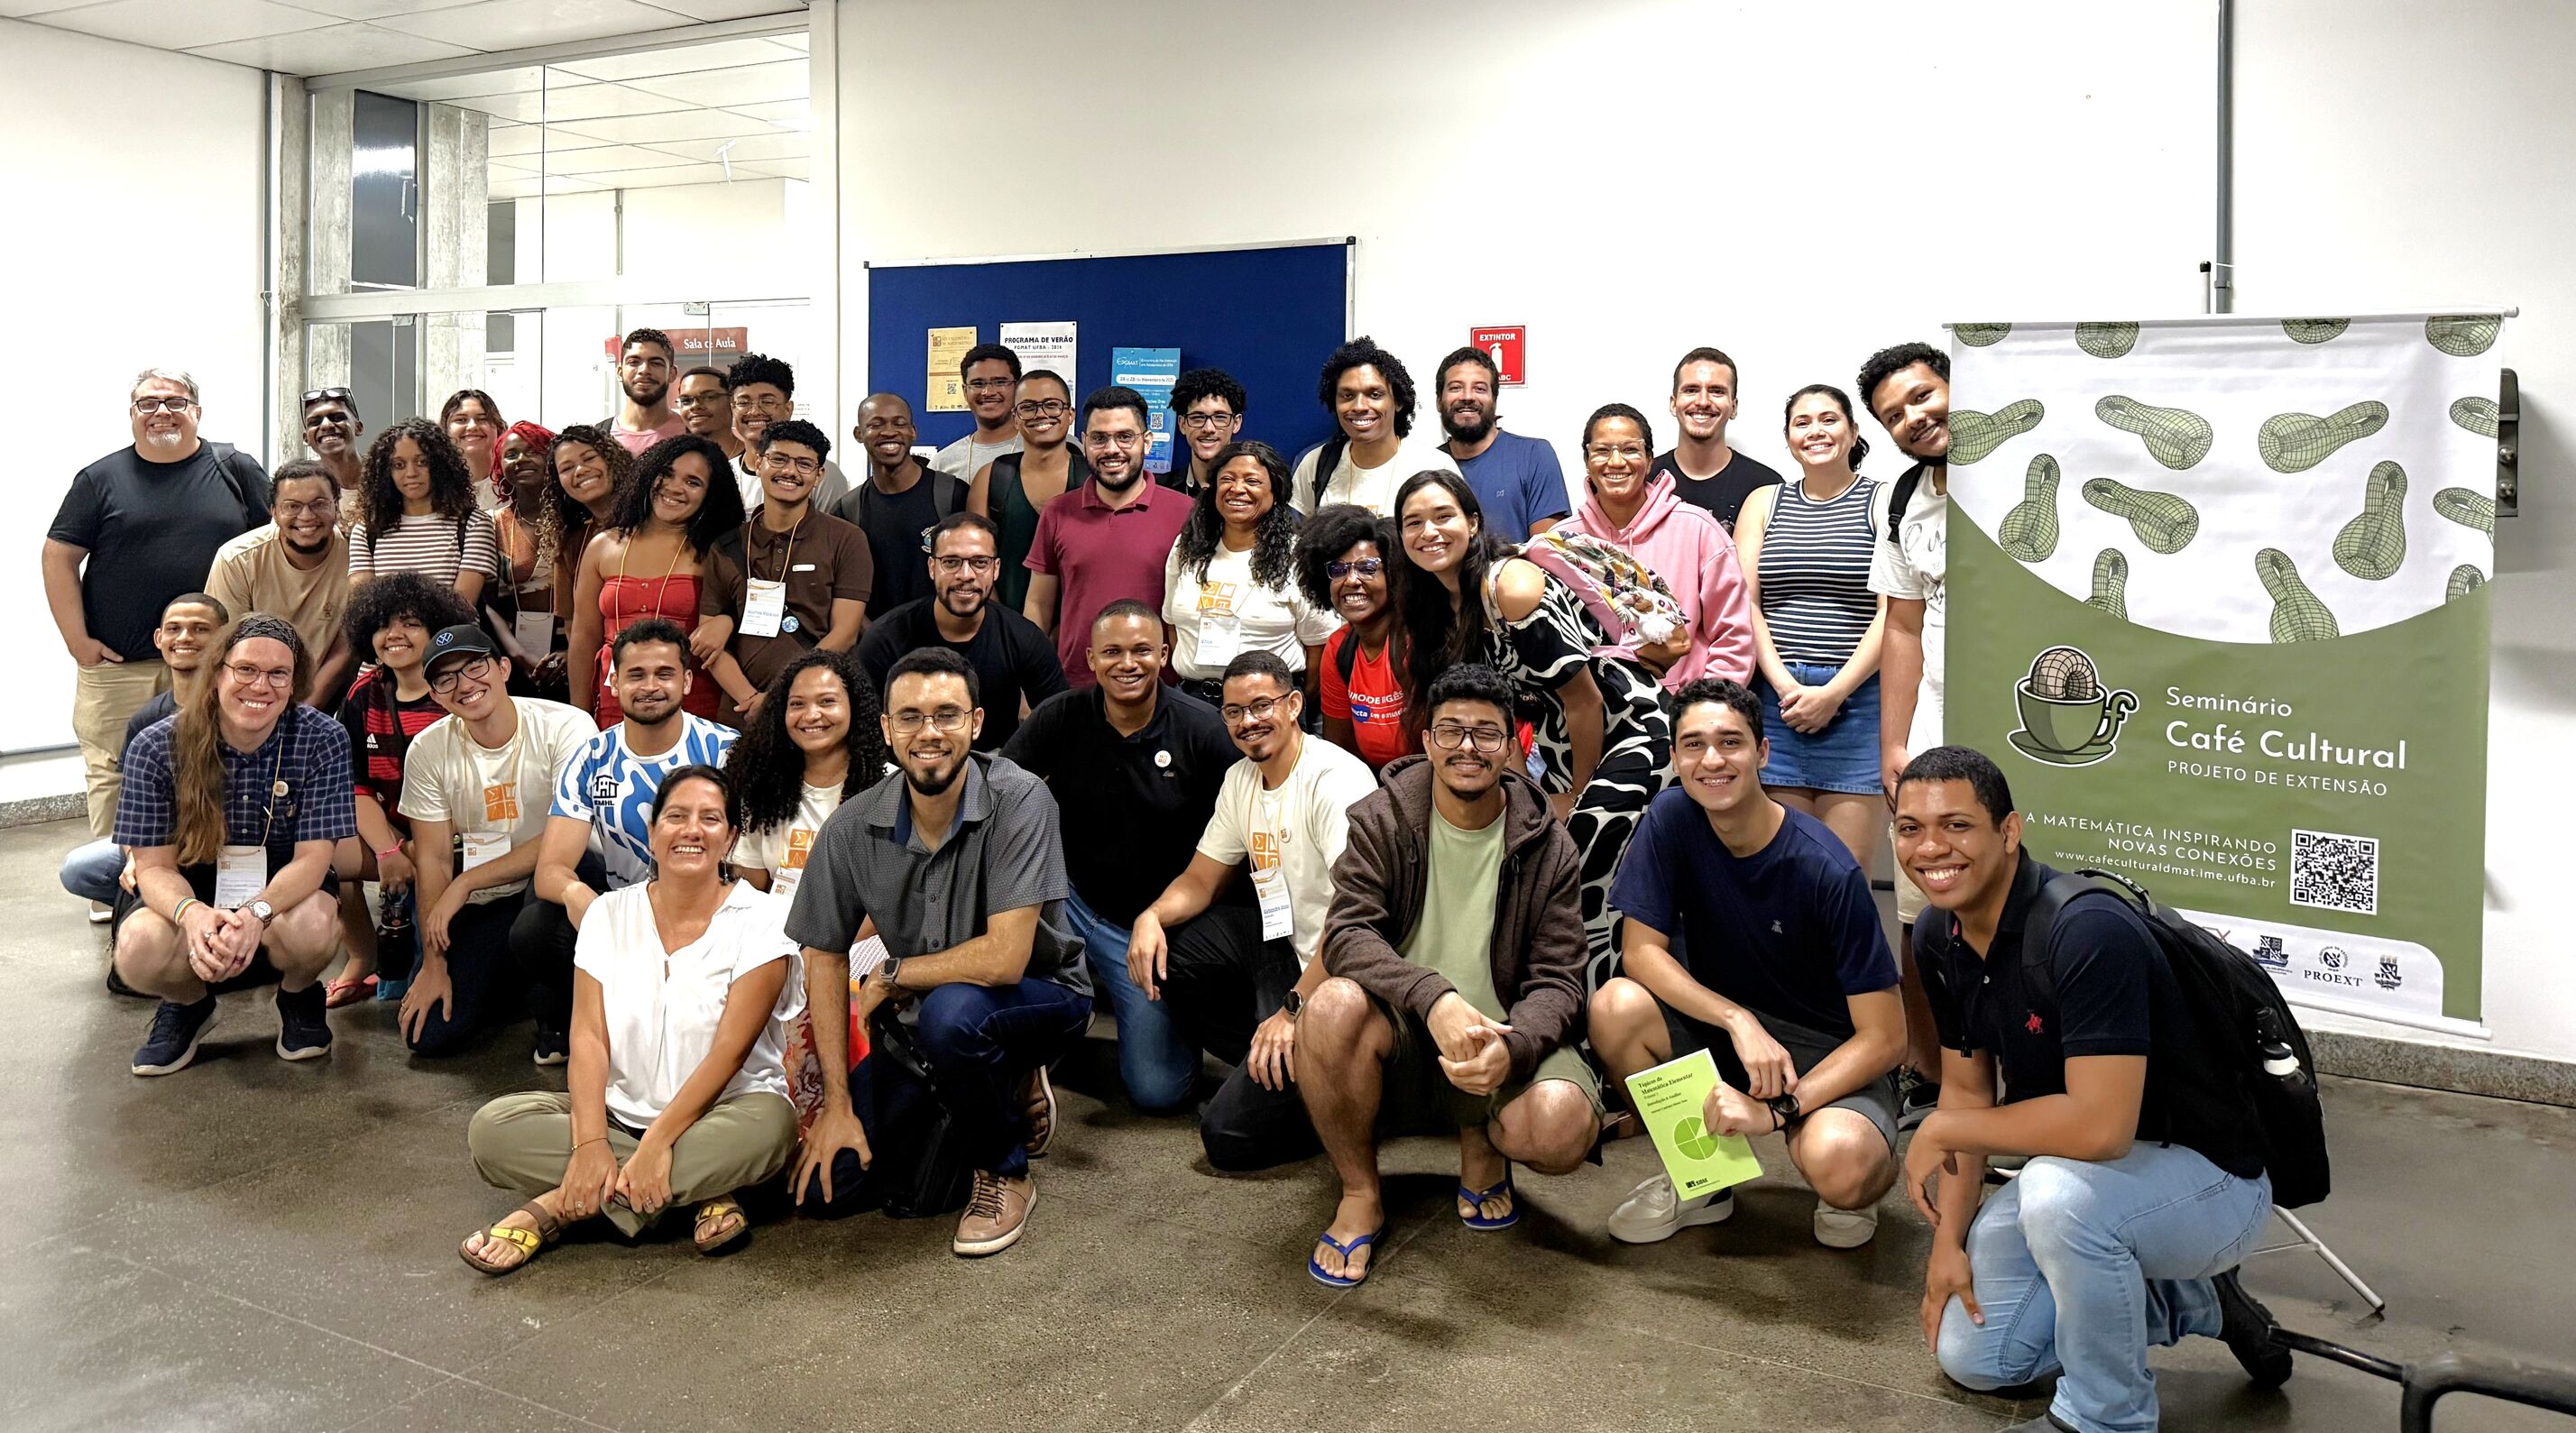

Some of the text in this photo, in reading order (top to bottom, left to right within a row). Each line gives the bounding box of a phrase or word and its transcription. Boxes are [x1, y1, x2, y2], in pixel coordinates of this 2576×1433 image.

[684, 338, 703, 349] Sala
[716, 336, 736, 348] Aula
[1051, 335, 1073, 343] VERÃO
[1480, 334, 1516, 342] EXTINTOR
[2166, 686, 2293, 717] Seminário
[2166, 721, 2406, 769] Café Cultural
[2167, 760, 2387, 796] PROJETO DE EXTENSÃO
[2026, 813, 2277, 854] A MATEMÁTICA INSPIRANDO
[2055, 850, 2277, 888] www.cafeculturaldmat.ime.ufba.br
[2108, 839, 2277, 871] NOVAS CONEXÕES
[2304, 969, 2363, 987] PROEXT
